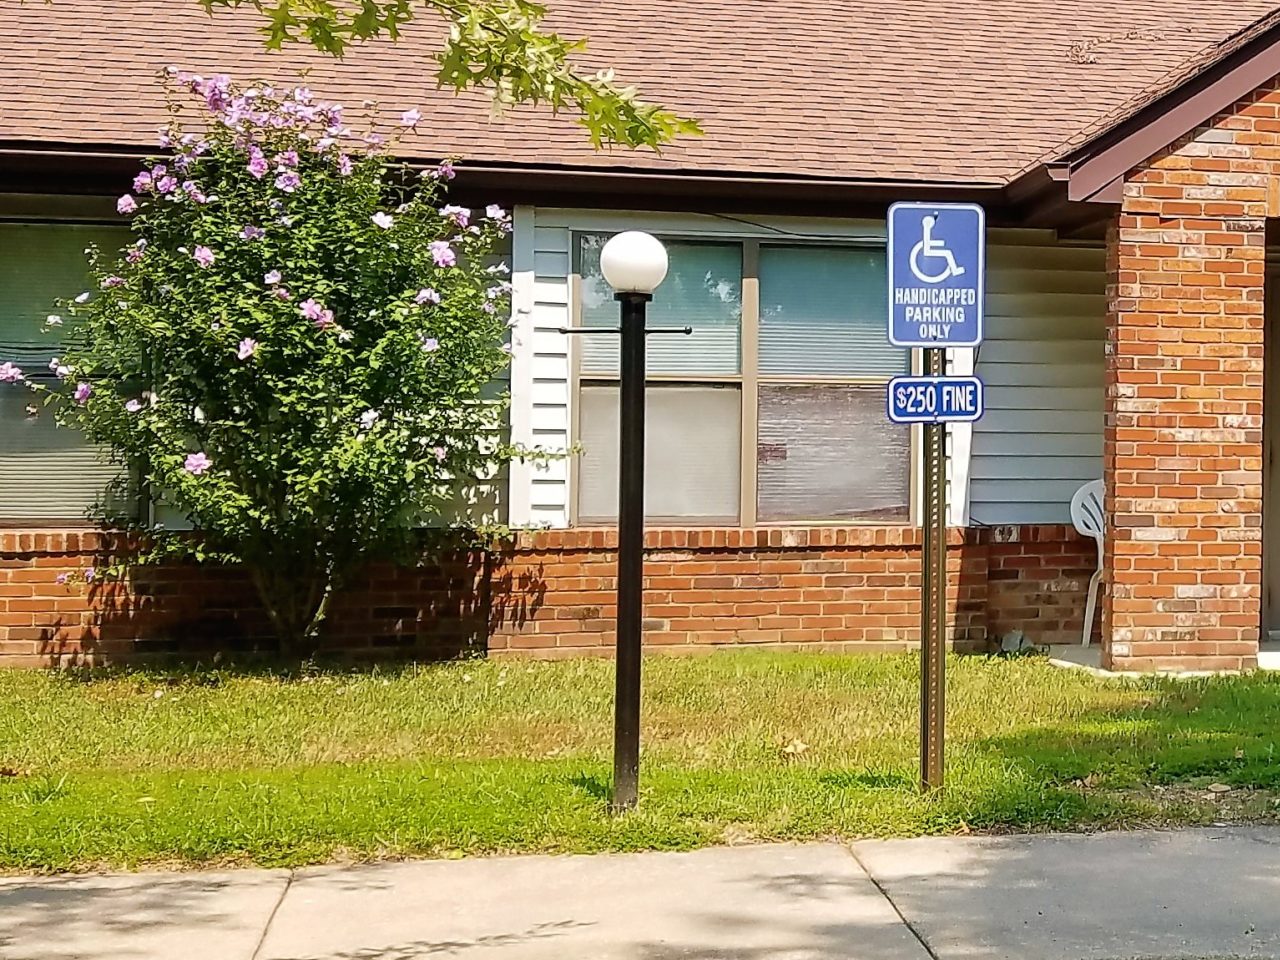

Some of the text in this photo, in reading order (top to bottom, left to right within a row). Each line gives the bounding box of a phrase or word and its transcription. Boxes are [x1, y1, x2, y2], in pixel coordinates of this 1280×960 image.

[895, 288, 976, 305] HANDICAPPED
[905, 307, 965, 322] PARKING
[919, 324, 951, 339] ONLY
[896, 386, 975, 412] $250 FINE
